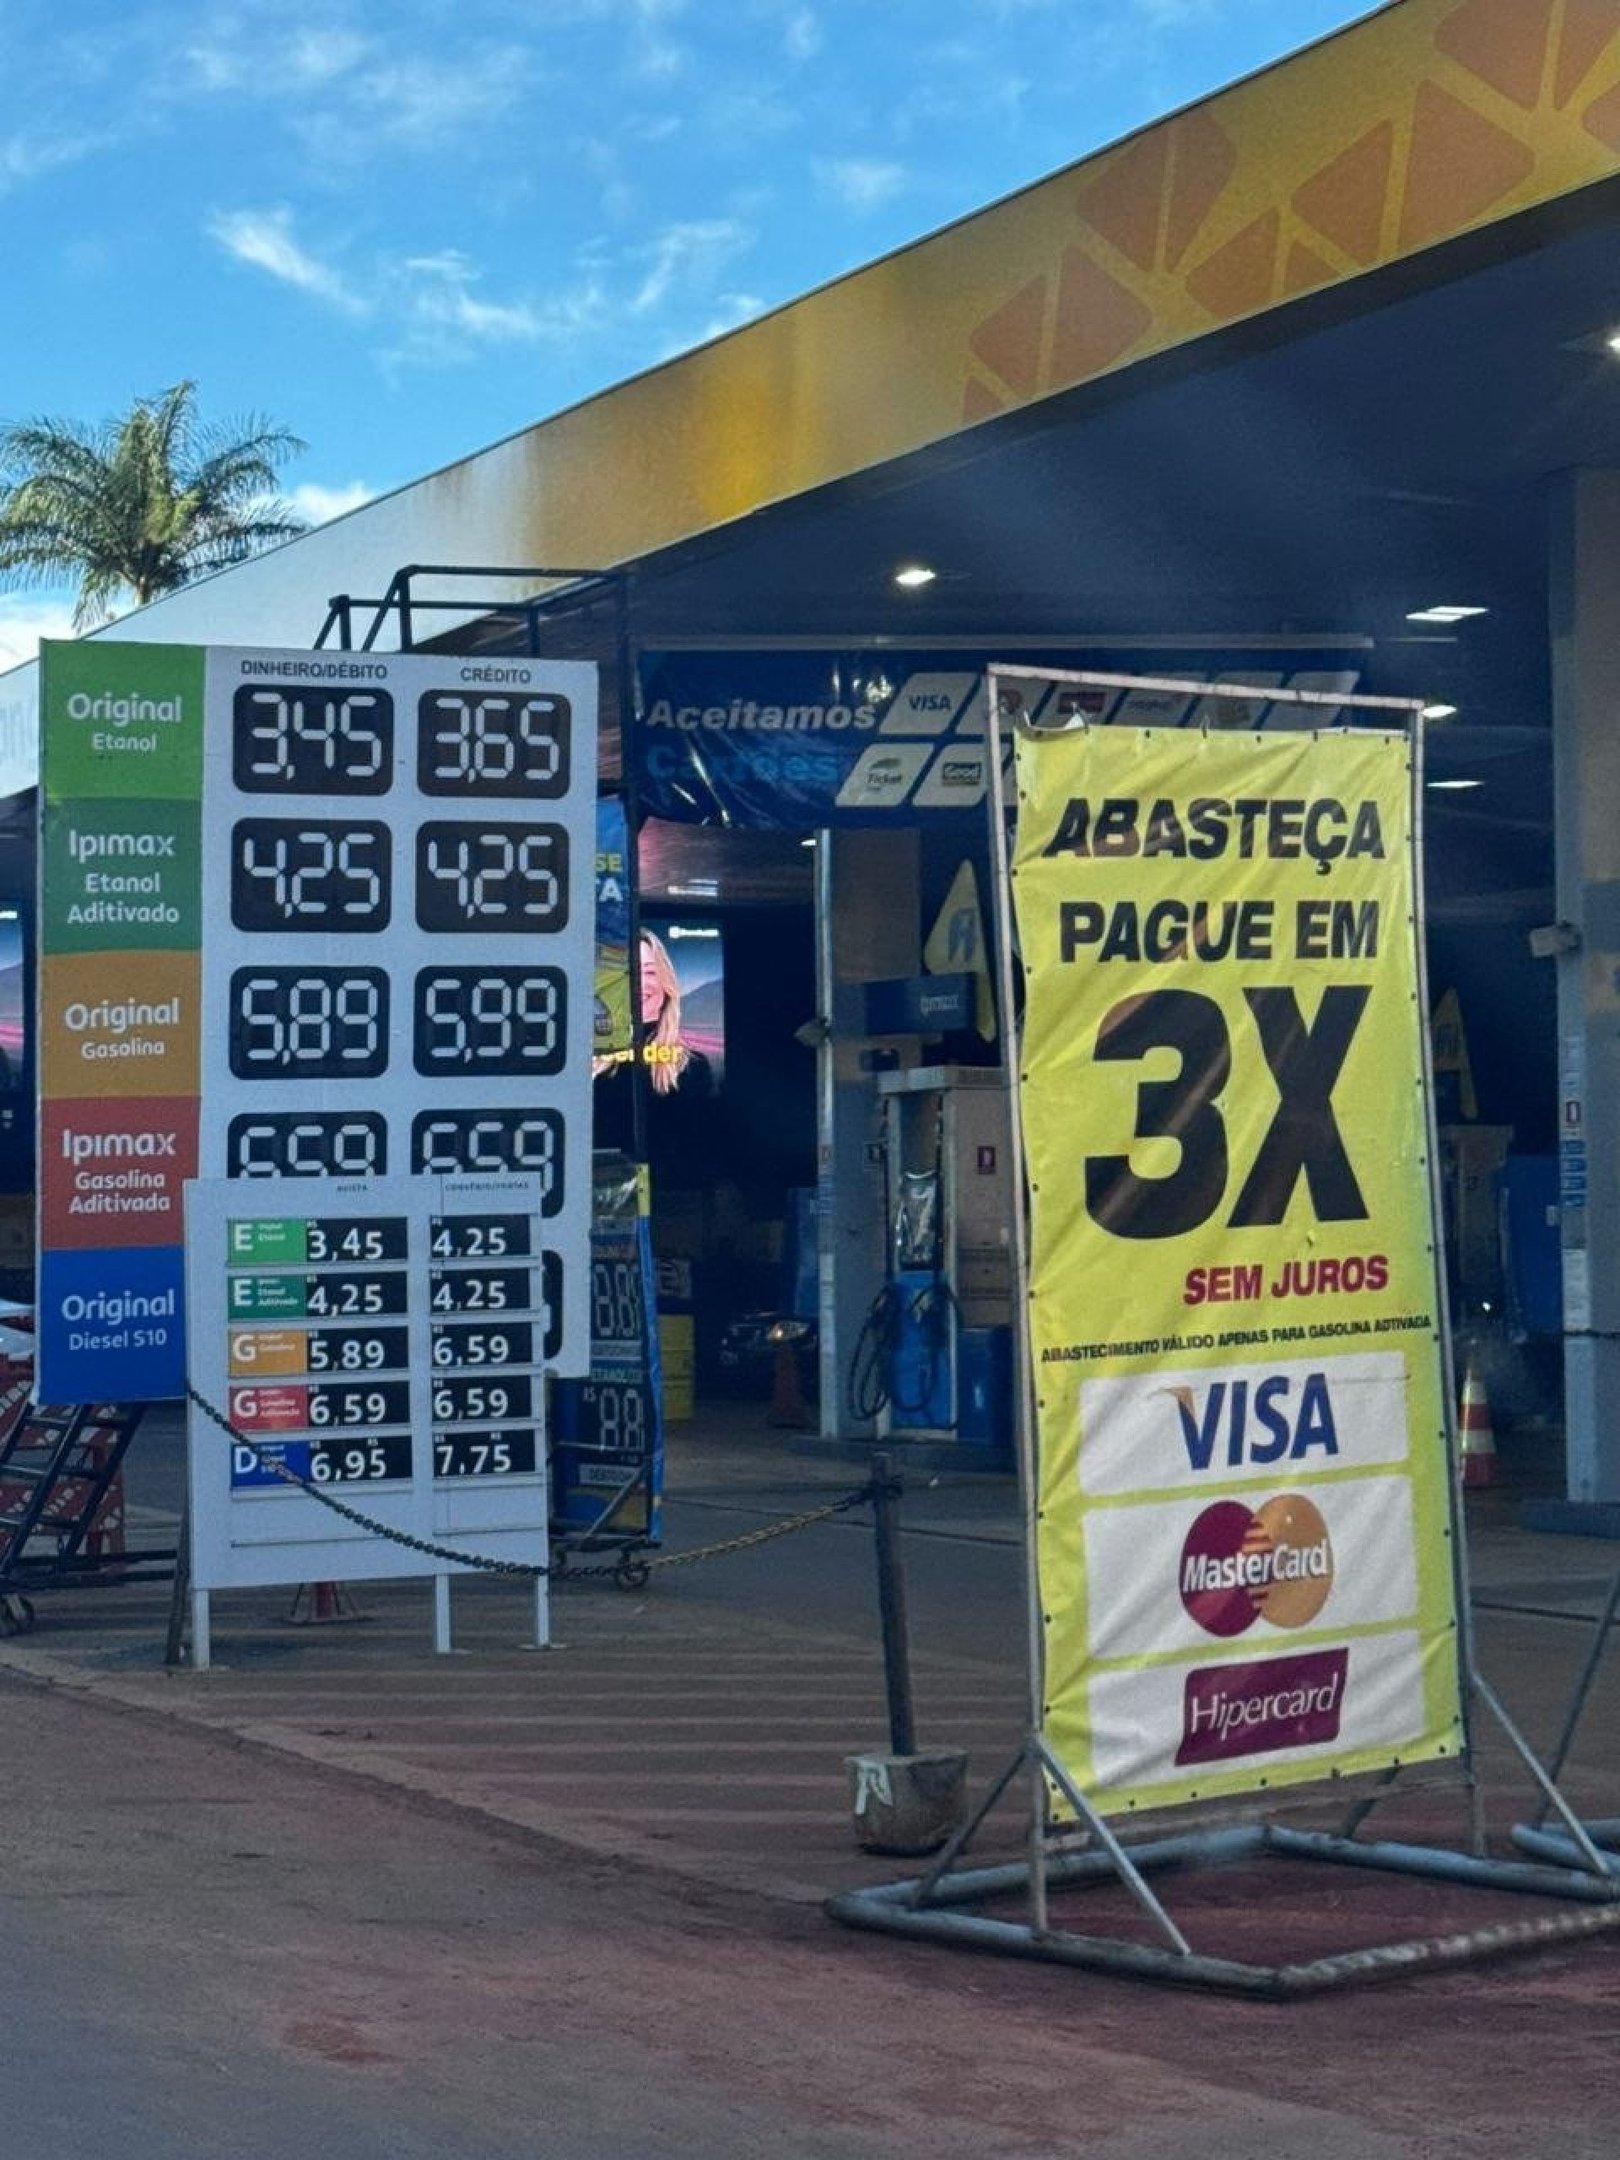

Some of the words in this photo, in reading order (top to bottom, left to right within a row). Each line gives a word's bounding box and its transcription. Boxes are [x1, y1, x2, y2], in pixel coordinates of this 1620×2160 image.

[240, 659, 389, 681] DINHEIRO/DÉBITO
[460, 663, 532, 684] CRÉDITO
[67, 691, 182, 727] Original
[648, 698, 877, 731] Aceitamos
[907, 694, 951, 712] VISA
[93, 733, 157, 751] Etanol
[251, 692, 383, 779] 3,45
[435, 697, 560, 782] 3,65
[1041, 797, 1386, 876] ABASTEÇA
[85, 872, 161, 893] Etanol
[243, 832, 380, 918] 4,25
[428, 834, 558, 918] 4,25
[67, 902, 180, 924] Aditivado
[1059, 900, 1274, 963] PAGUE
[1295, 900, 1379, 960] EM
[65, 997, 181, 1034] Original
[242, 979, 378, 1065] 5,89
[426, 978, 556, 1064] 5,99
[81, 1039, 165, 1060] Gasolina
[1084, 985, 1373, 1240] 3X
[75, 1172, 166, 1190] Gasolina
[69, 1192, 170, 1214] Aditivada
[234, 1223, 254, 1251] E
[308, 1228, 384, 1262] 3,45
[433, 1227, 507, 1257] 4,25
[233, 1279, 253, 1306] E
[433, 1280, 507, 1310] 4,25
[1184, 1263, 1264, 1306] SEM
[1271, 1254, 1389, 1298] JUROS
[61, 1288, 175, 1325] Original
[307, 1284, 384, 1316] 4,25
[69, 1329, 129, 1351] Diesel
[132, 1328, 168, 1347] S10
[232, 1334, 257, 1362] G
[434, 1335, 510, 1366] 6,59
[1041, 1338, 1160, 1363] ABASTECIMENTO
[1162, 1332, 1214, 1351] VÁLIDO
[1217, 1328, 1268, 1347] APENAS
[1272, 1325, 1305, 1342] PARA
[1308, 1320, 1371, 1339] GASOLINA
[310, 1340, 385, 1372] 5,89
[234, 1389, 258, 1418] G
[310, 1393, 387, 1426] 6,59
[434, 1388, 509, 1420] 6,59
[1166, 1372, 1339, 1471] VISA
[234, 1447, 258, 1474] D
[311, 1449, 387, 1481] 6,95
[436, 1444, 512, 1475] 7,75
[1182, 1538, 1329, 1594] MasterCard
[1190, 1674, 1339, 1741] Hipercard
